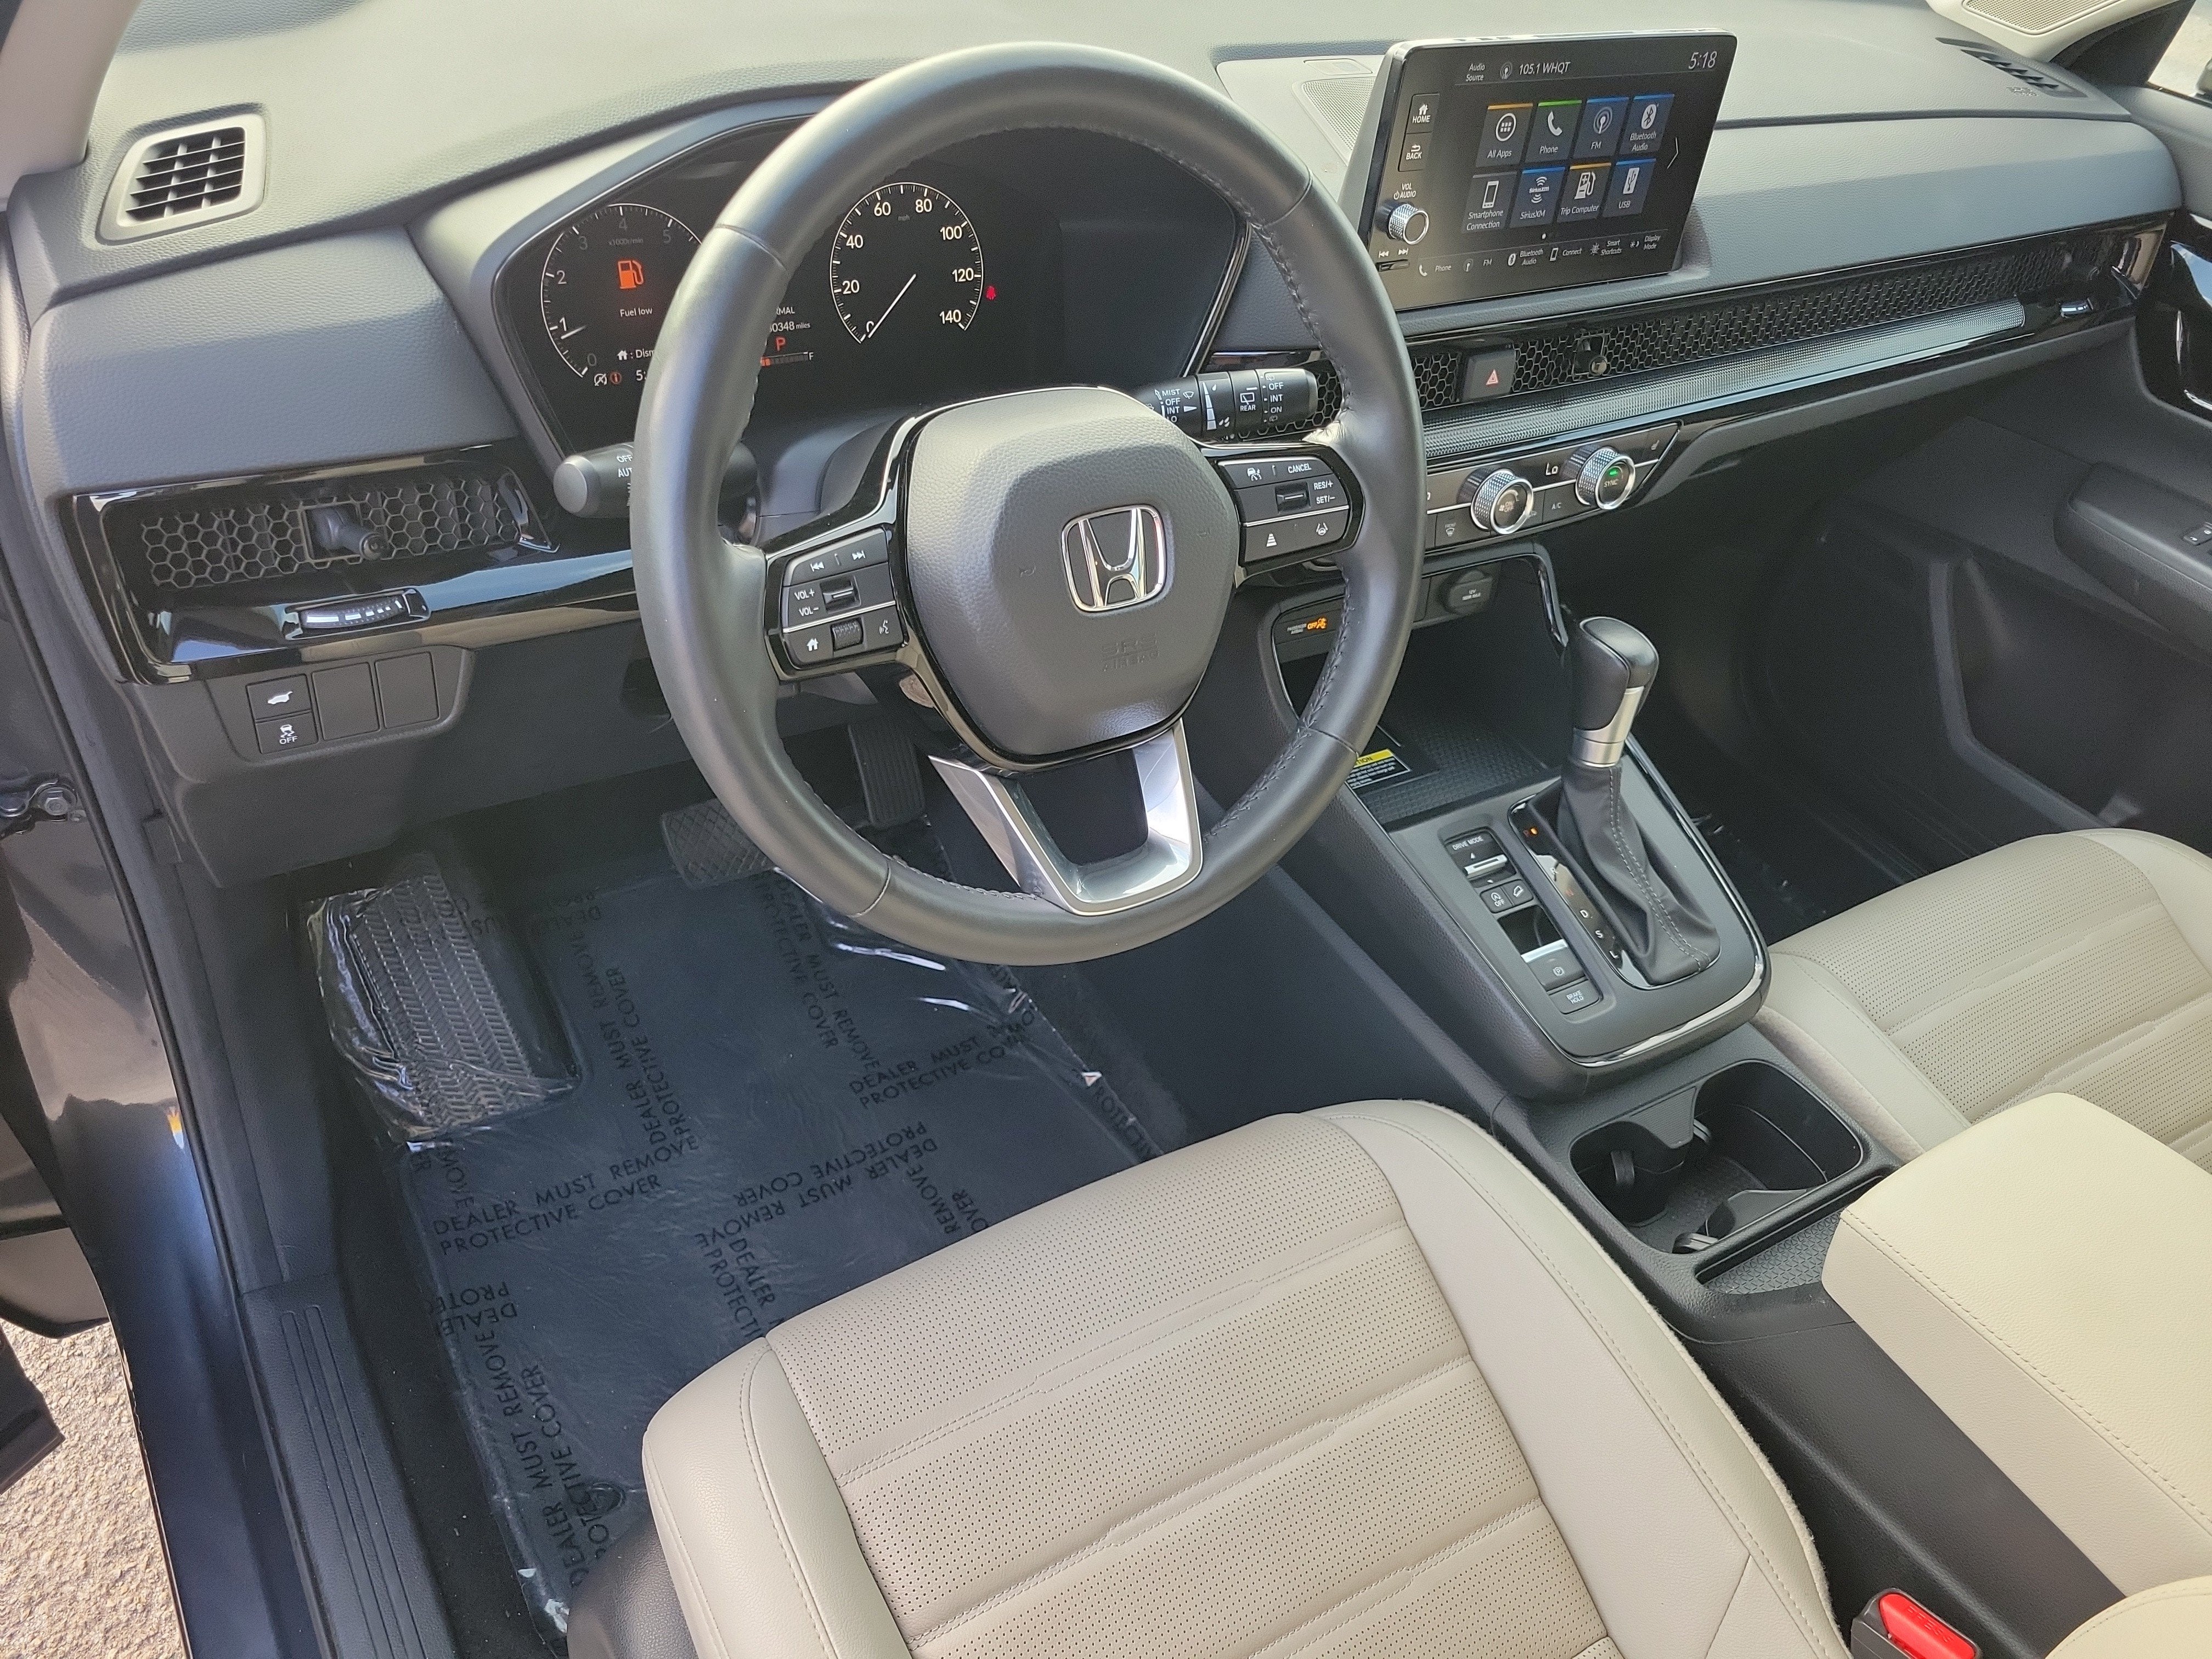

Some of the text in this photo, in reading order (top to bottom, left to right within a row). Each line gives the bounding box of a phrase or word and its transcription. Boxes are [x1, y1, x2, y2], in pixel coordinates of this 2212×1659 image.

[1469, 63, 1485, 71] Audio
[1688, 51, 1717, 70] 5:18
[1519, 61, 1571, 75] 105.1 WHQT
[1412, 115, 1431, 123] HOME
[1630, 131, 1657, 140] Bluetooth
[1539, 145, 1558, 154] Phone
[1632, 143, 1649, 151] Audio
[1406, 151, 1422, 160] BACK
[1487, 149, 1512, 159] All Apps
[874, 201, 891, 217] 60
[915, 198, 932, 213] 80
[1561, 204, 1599, 216] Trip Computer
[1618, 200, 1630, 209] USB
[1468, 210, 1503, 219] Smartphone
[1520, 210, 1546, 219] SiriusXM
[619, 218, 628, 231] 4
[1466, 220, 1500, 230] Connection
[663, 230, 672, 243] 5
[940, 225, 962, 240] 100
[578, 236, 589, 251] 3
[845, 234, 864, 249] 40
[1519, 249, 1543, 257] Bluetooth
[1562, 248, 1582, 256] Connect
[556, 270, 567, 285] 2
[952, 268, 974, 283] 120
[842, 279, 860, 295] 20
[620, 307, 653, 317] Fuel low
[939, 309, 961, 324] 140
[559, 317, 567, 332] 1
[769, 321, 811, 332] 0348 miles
[775, 336, 786, 351] P
[586, 353, 597, 366] 0
[809, 352, 815, 362] F
[1162, 388, 1181, 397] MIST
[1268, 382, 1284, 391] OFF
[1165, 398, 1181, 407] OFF
[1270, 394, 1284, 403] INT
[1166, 406, 1180, 415] INT
[616, 454, 633, 463] OFF
[1288, 463, 1312, 473] CANCEL
[1545, 462, 1559, 476] Lo
[1313, 479, 1334, 490] RES/+
[1316, 495, 1336, 504] SET/-
[794, 588, 815, 601] VOL+
[1307, 622, 1318, 630] OFF
[279, 736, 298, 745] OFF
[1452, 836, 1483, 851] DRIVE MODE
[1580, 910, 1588, 918] D
[1595, 929, 1604, 939] S
[1609, 950, 1619, 959] L
[1566, 990, 1582, 1000] BRAKE
[1570, 995, 1585, 1005] HOLD
[802, 991, 839, 1050] COVER
[600, 1020, 633, 1070] MUST
[833, 1009, 881, 1070] REMOVE
[606, 966, 691, 1138] PROTECTIVE COVER
[850, 1059, 916, 1094] DEALER
[932, 1036, 979, 1064] MUST
[859, 1060, 971, 1109] PROTECTIVE
[625, 1079, 667, 1146] DEALER
[736, 1121, 928, 1208] PROTECTIVE COVER
[432, 1135, 700, 1237] DEALER MUST REMOVE
[695, 1138, 938, 1251] DEALER MUST REMOVE
[906, 1165, 961, 1235] REMOVE
[439, 1173, 662, 1256] PROTECTIVE COVER
[729, 1238, 776, 1308] DEALER
[521, 1364, 562, 1440] COVER
[475, 1329, 590, 1589] DEALER MUST REMOVE
